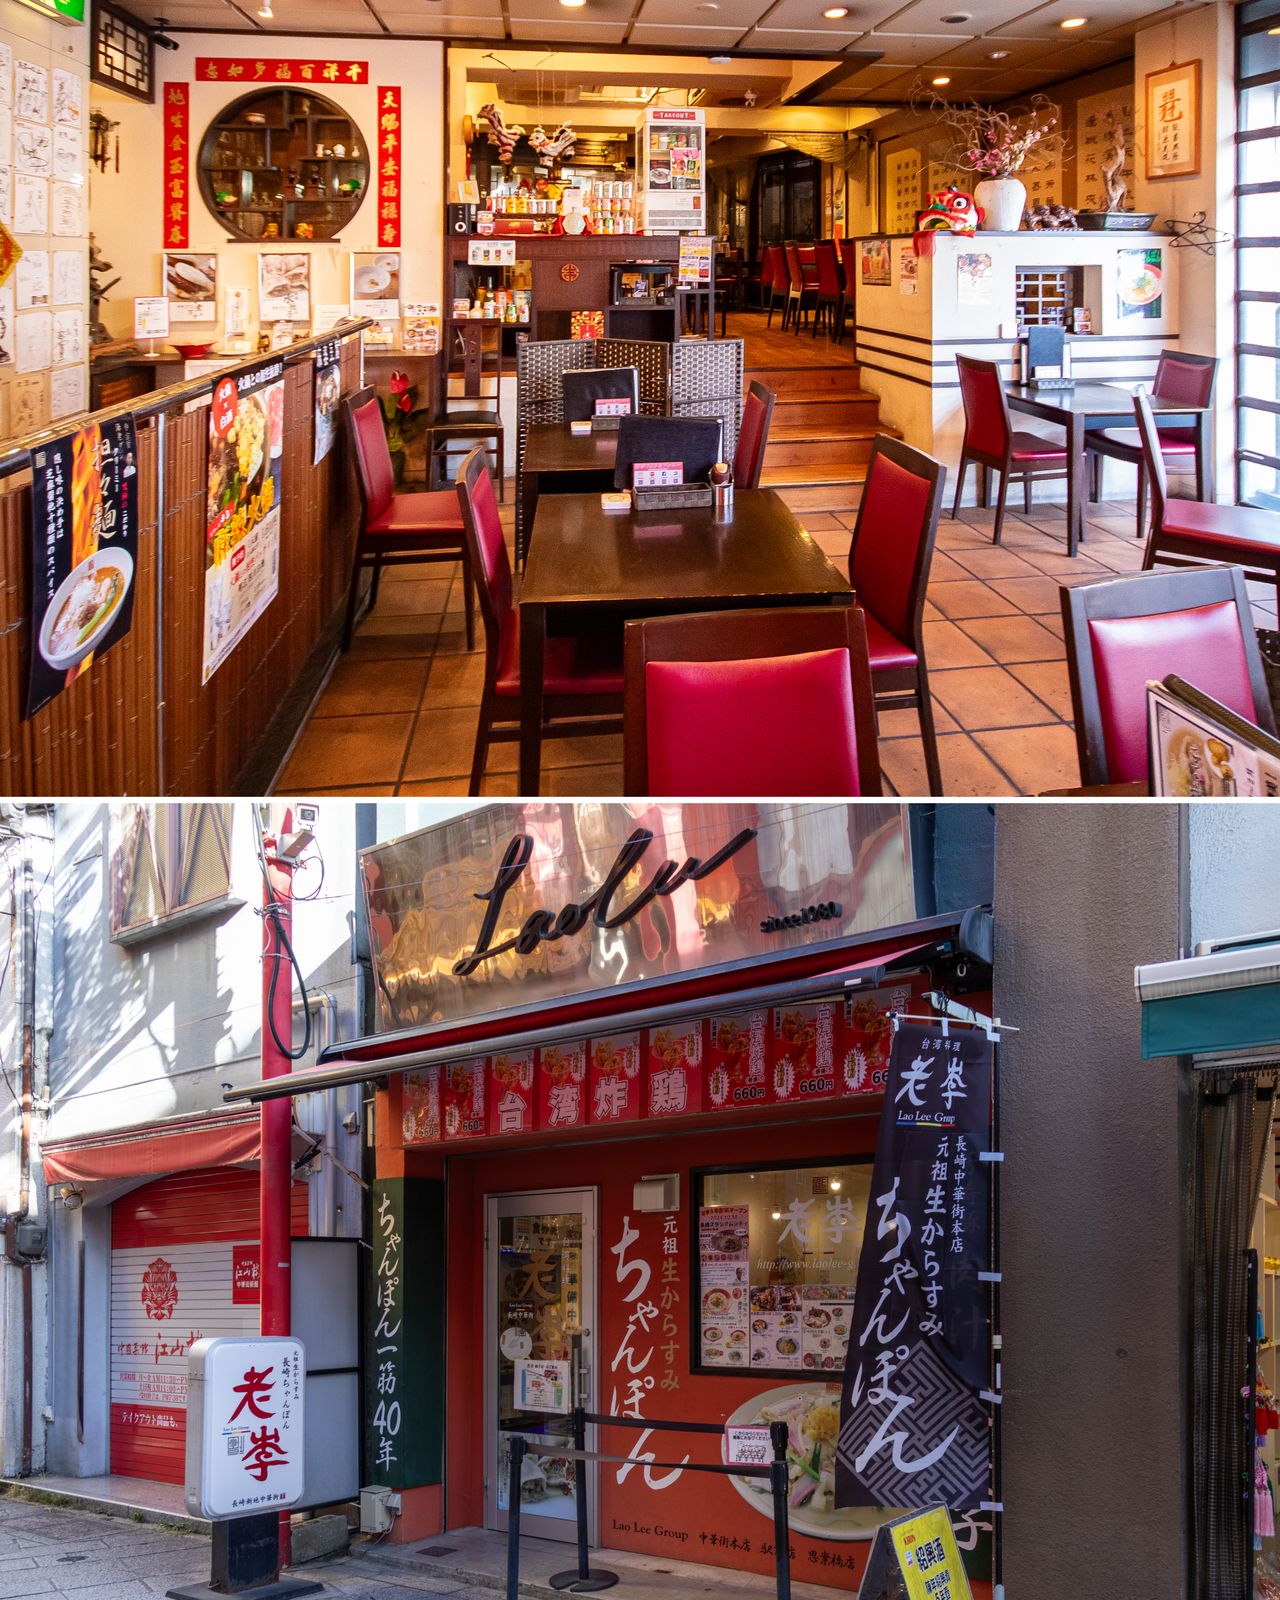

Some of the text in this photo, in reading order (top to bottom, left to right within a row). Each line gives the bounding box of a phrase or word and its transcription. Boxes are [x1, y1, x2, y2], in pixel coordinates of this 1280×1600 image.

[922, 1037, 961, 1052] 台湾料理
[733, 1086, 765, 1101] 660円
[800, 1078, 834, 1093] 660円
[898, 1110, 913, 1121] Lao
[915, 1110, 932, 1121] Lee
[950, 1135, 967, 1253] 長崎中華街本店
[919, 1136, 949, 1336] 元祖生からすみ
[660, 1216, 680, 1392] 元祖生からすみ
[851, 1176, 960, 1474] ちゃんぽん
[610, 1216, 690, 1490] ちゃんぽん
[281, 1357, 291, 1430] 長崎ちゃんぽん
[613, 1519, 631, 1532] Lao
[634, 1522, 651, 1534] Lee
[654, 1526, 689, 1542] Group
[699, 1531, 751, 1553] 中華街本店
